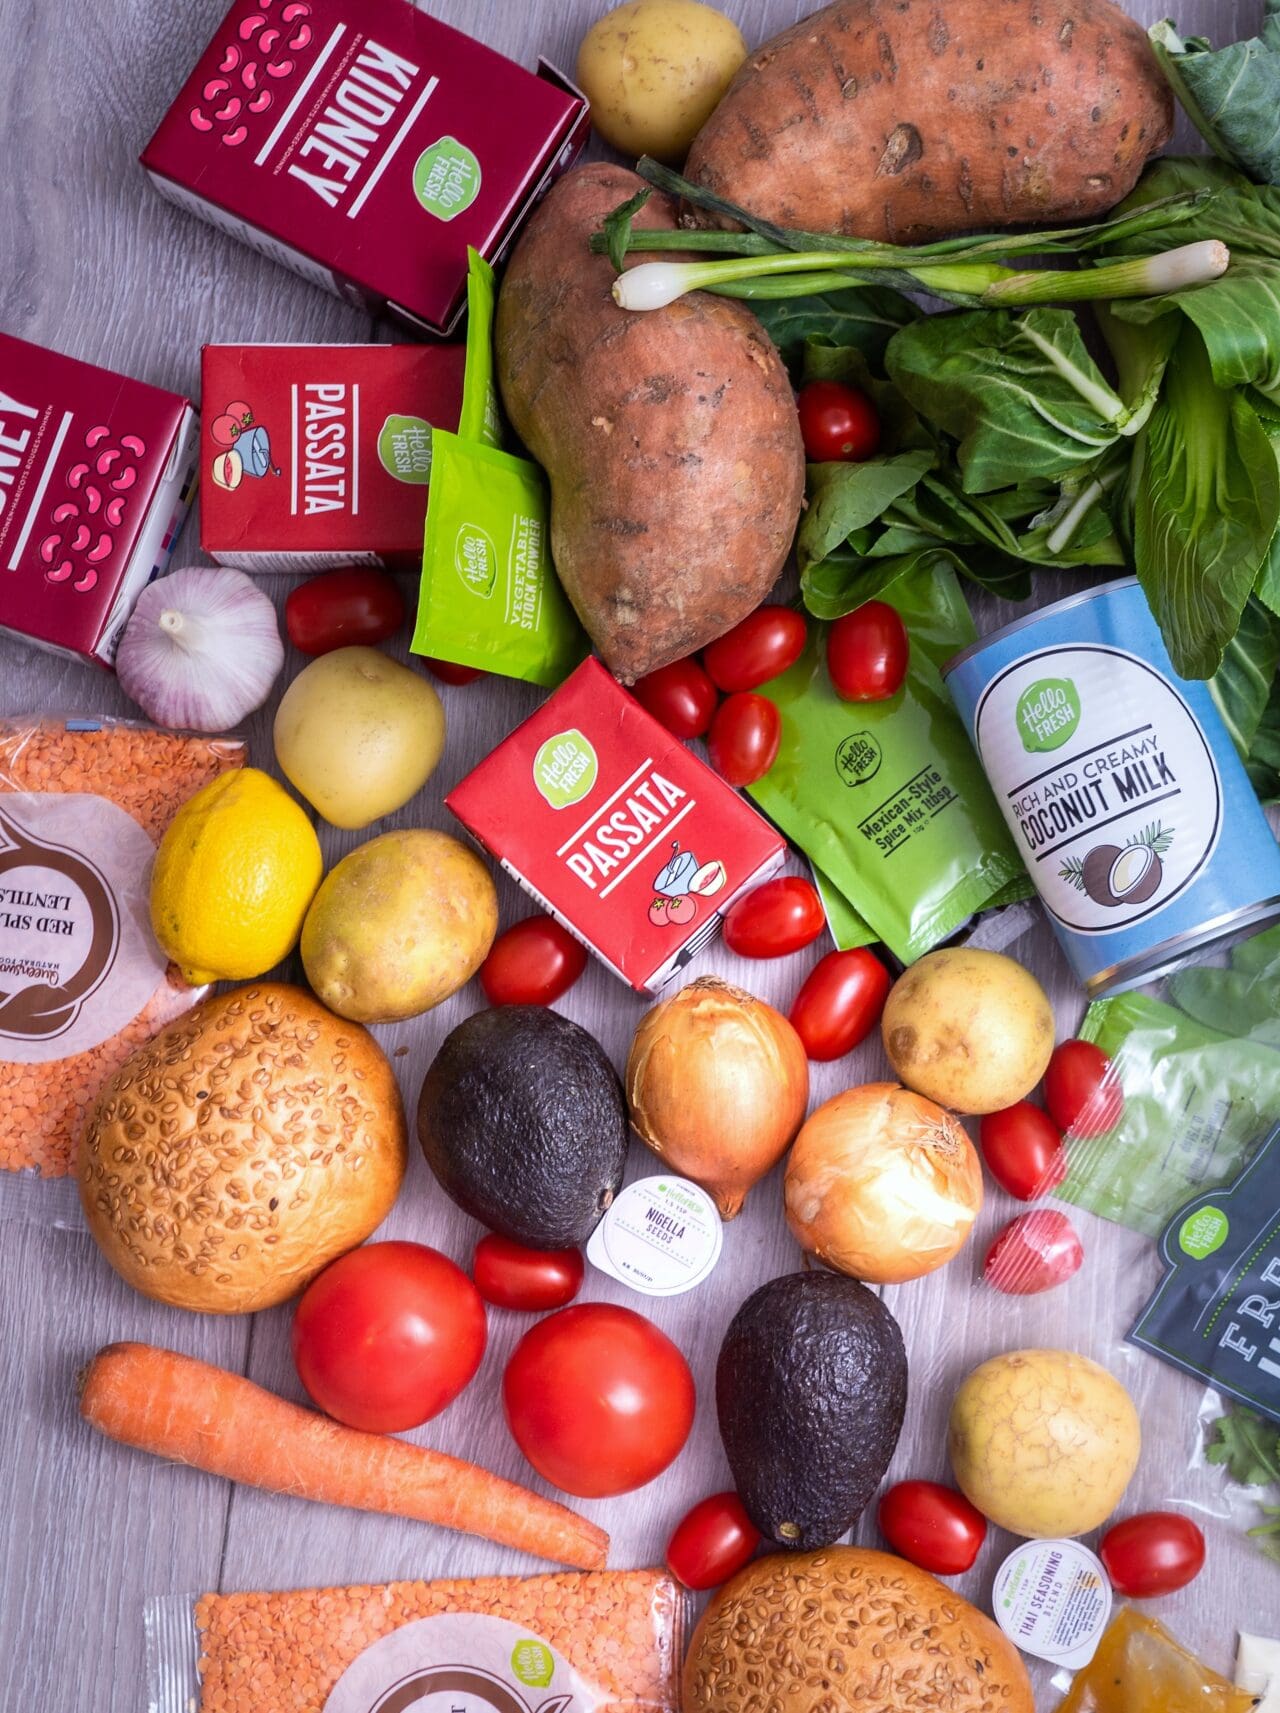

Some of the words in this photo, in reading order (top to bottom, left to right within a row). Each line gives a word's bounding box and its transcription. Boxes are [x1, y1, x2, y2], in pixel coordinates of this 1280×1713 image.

[287, 39, 420, 208] KIDNEY
[423, 155, 450, 201] FRESH
[439, 156, 473, 208] Hello
[304, 383, 346, 515] PASSATA
[391, 434, 412, 473] FRESH
[403, 426, 433, 473] Hello
[463, 536, 482, 583] Hello
[477, 537, 489, 580] FRESH
[511, 515, 529, 625] VEGETABLE
[527, 518, 541, 579] POWDER
[521, 583, 537, 629] STOCK
[1022, 688, 1067, 733] Hello
[1034, 703, 1076, 742] FRESH
[541, 741, 579, 790] Hello
[558, 751, 591, 795] FRESH
[840, 739, 869, 773] Hello
[852, 747, 878, 777] FRESH
[1012, 792, 1041, 818] RICH
[1043, 772, 1078, 799] AND
[1083, 735, 1160, 779] CREAMY
[860, 770, 943, 841] Mexican-Style
[875, 823, 907, 851] Spice
[903, 804, 926, 830] Mix
[922, 785, 952, 813] 1tbsp
[1020, 778, 1110, 851] COCONUT
[1111, 751, 1176, 803] MILK
[565, 771, 687, 890] PASSATA
[0, 888, 71, 911] LENTILS
[0, 912, 32, 931] SPL
[36, 917, 75, 936] RED
[0, 957, 16, 965] FOO
[0, 963, 59, 986] Queenswo
[20, 958, 60, 970] NATURAL
[645, 1207, 686, 1239] NIGELLA
[646, 1223, 674, 1244] SEEDS
[1185, 1215, 1211, 1249] Hello
[1200, 1217, 1223, 1249] FRESH
[1019, 1611, 1040, 1637] THAI
[1030, 1551, 1063, 1610] SEASONING
[1043, 1581, 1063, 1617] BLEND
